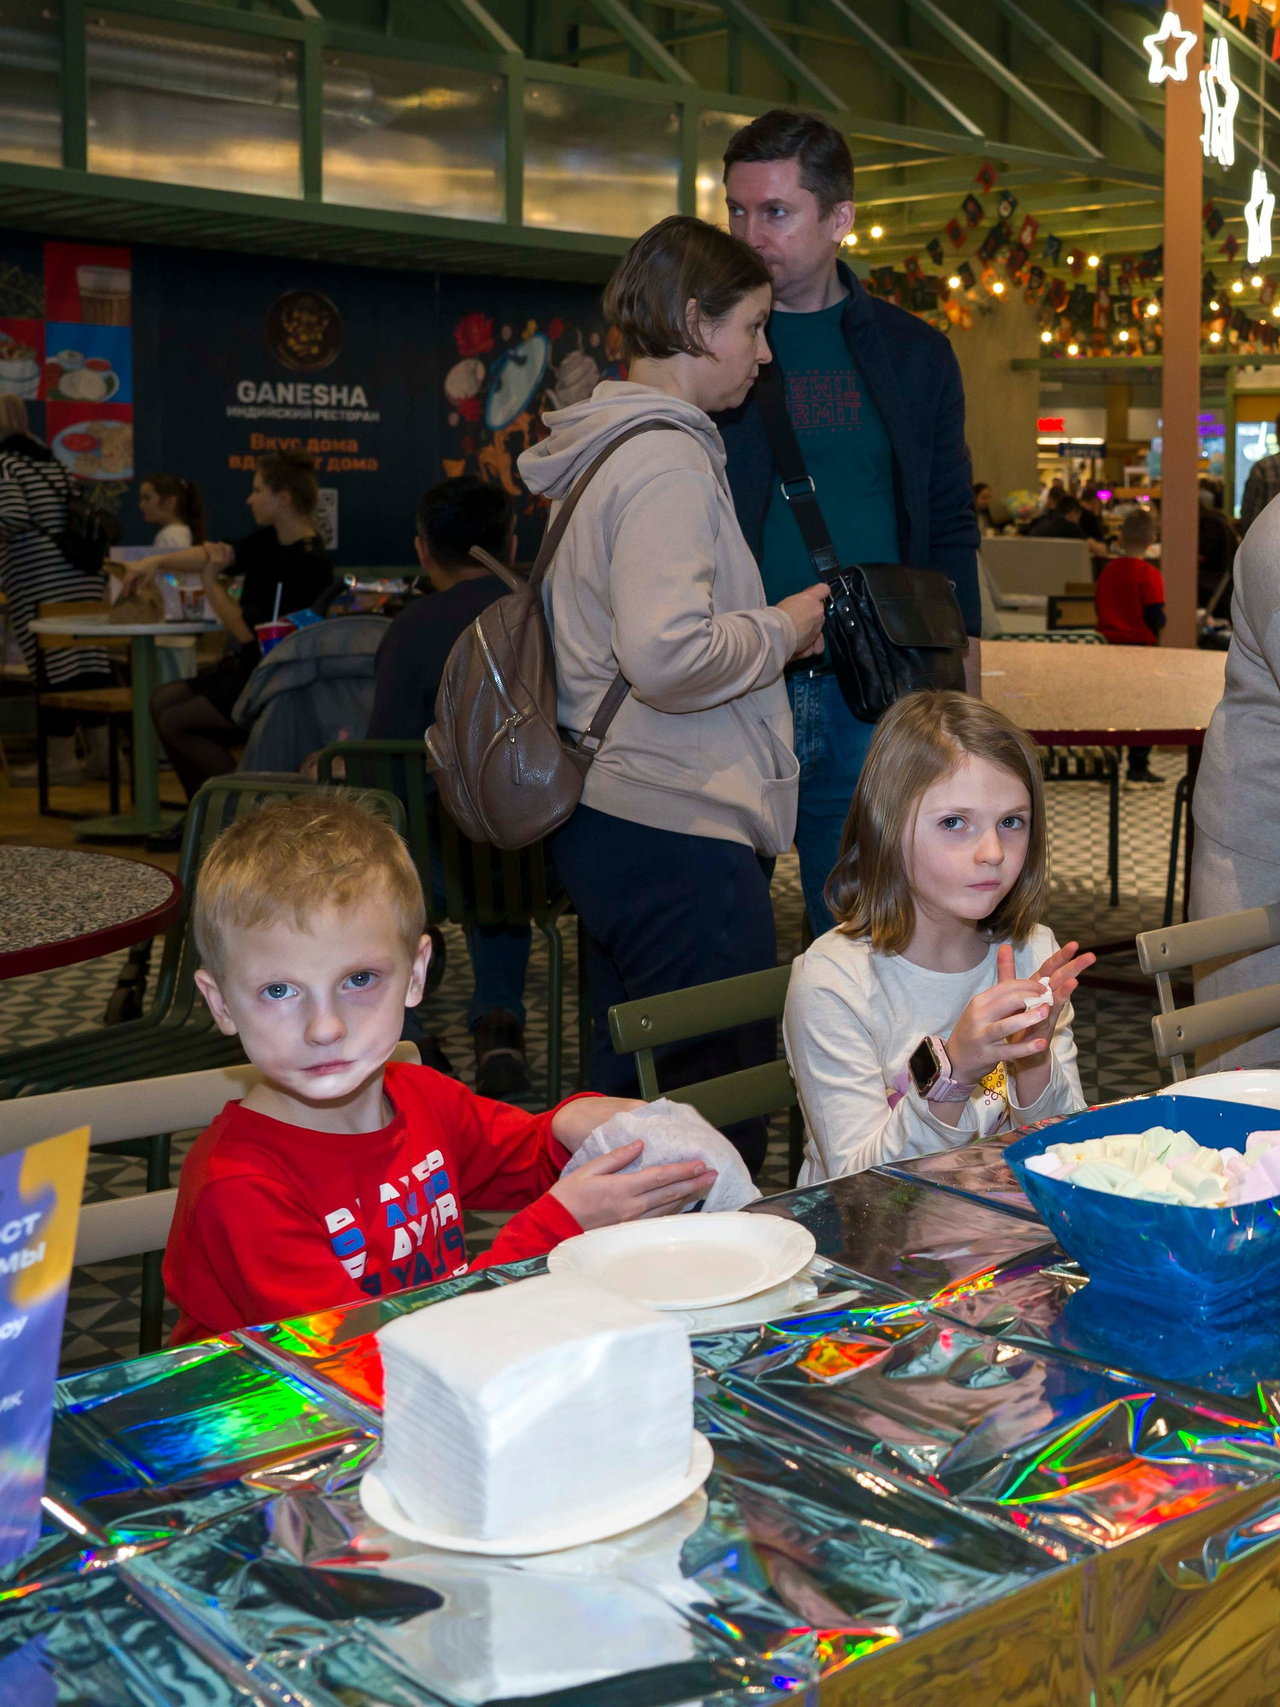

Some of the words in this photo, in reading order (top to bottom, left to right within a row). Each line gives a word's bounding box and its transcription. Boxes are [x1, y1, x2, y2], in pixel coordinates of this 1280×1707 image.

[236, 380, 368, 407] GANESHA
[226, 405, 313, 420] ИНДИЙСКИЙ
[314, 409, 380, 422] РЕСТОРАН
[307, 438, 359, 454] дома
[327, 456, 379, 472] дома
